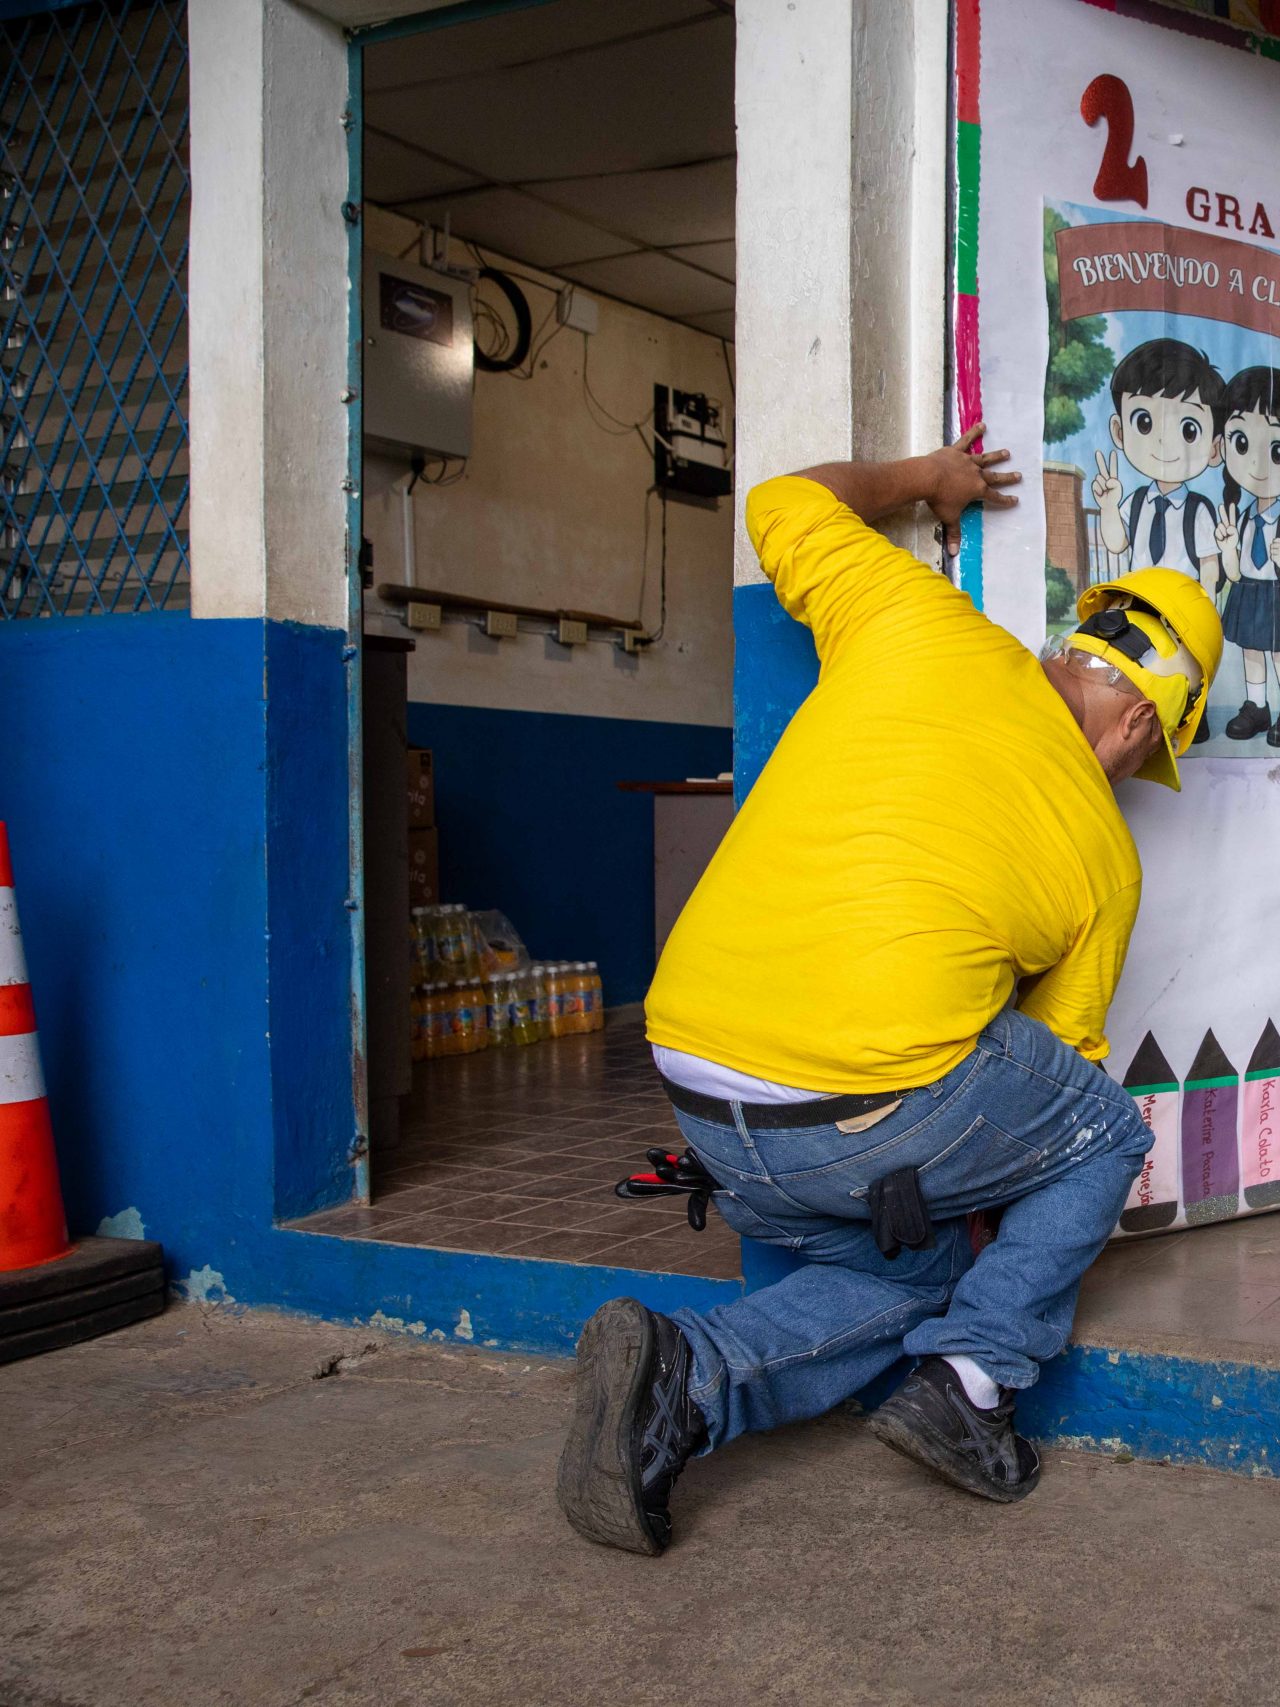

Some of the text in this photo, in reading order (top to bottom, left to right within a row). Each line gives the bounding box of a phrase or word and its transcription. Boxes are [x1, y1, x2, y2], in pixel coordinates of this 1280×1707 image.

[1080, 73, 1148, 210] 2
[1073, 252, 1220, 287] BIENVENIDO
[1229, 268, 1245, 295] A
[1260, 1080, 1276, 1125] Karla
[1202, 1087, 1218, 1197] Katerine Parada
